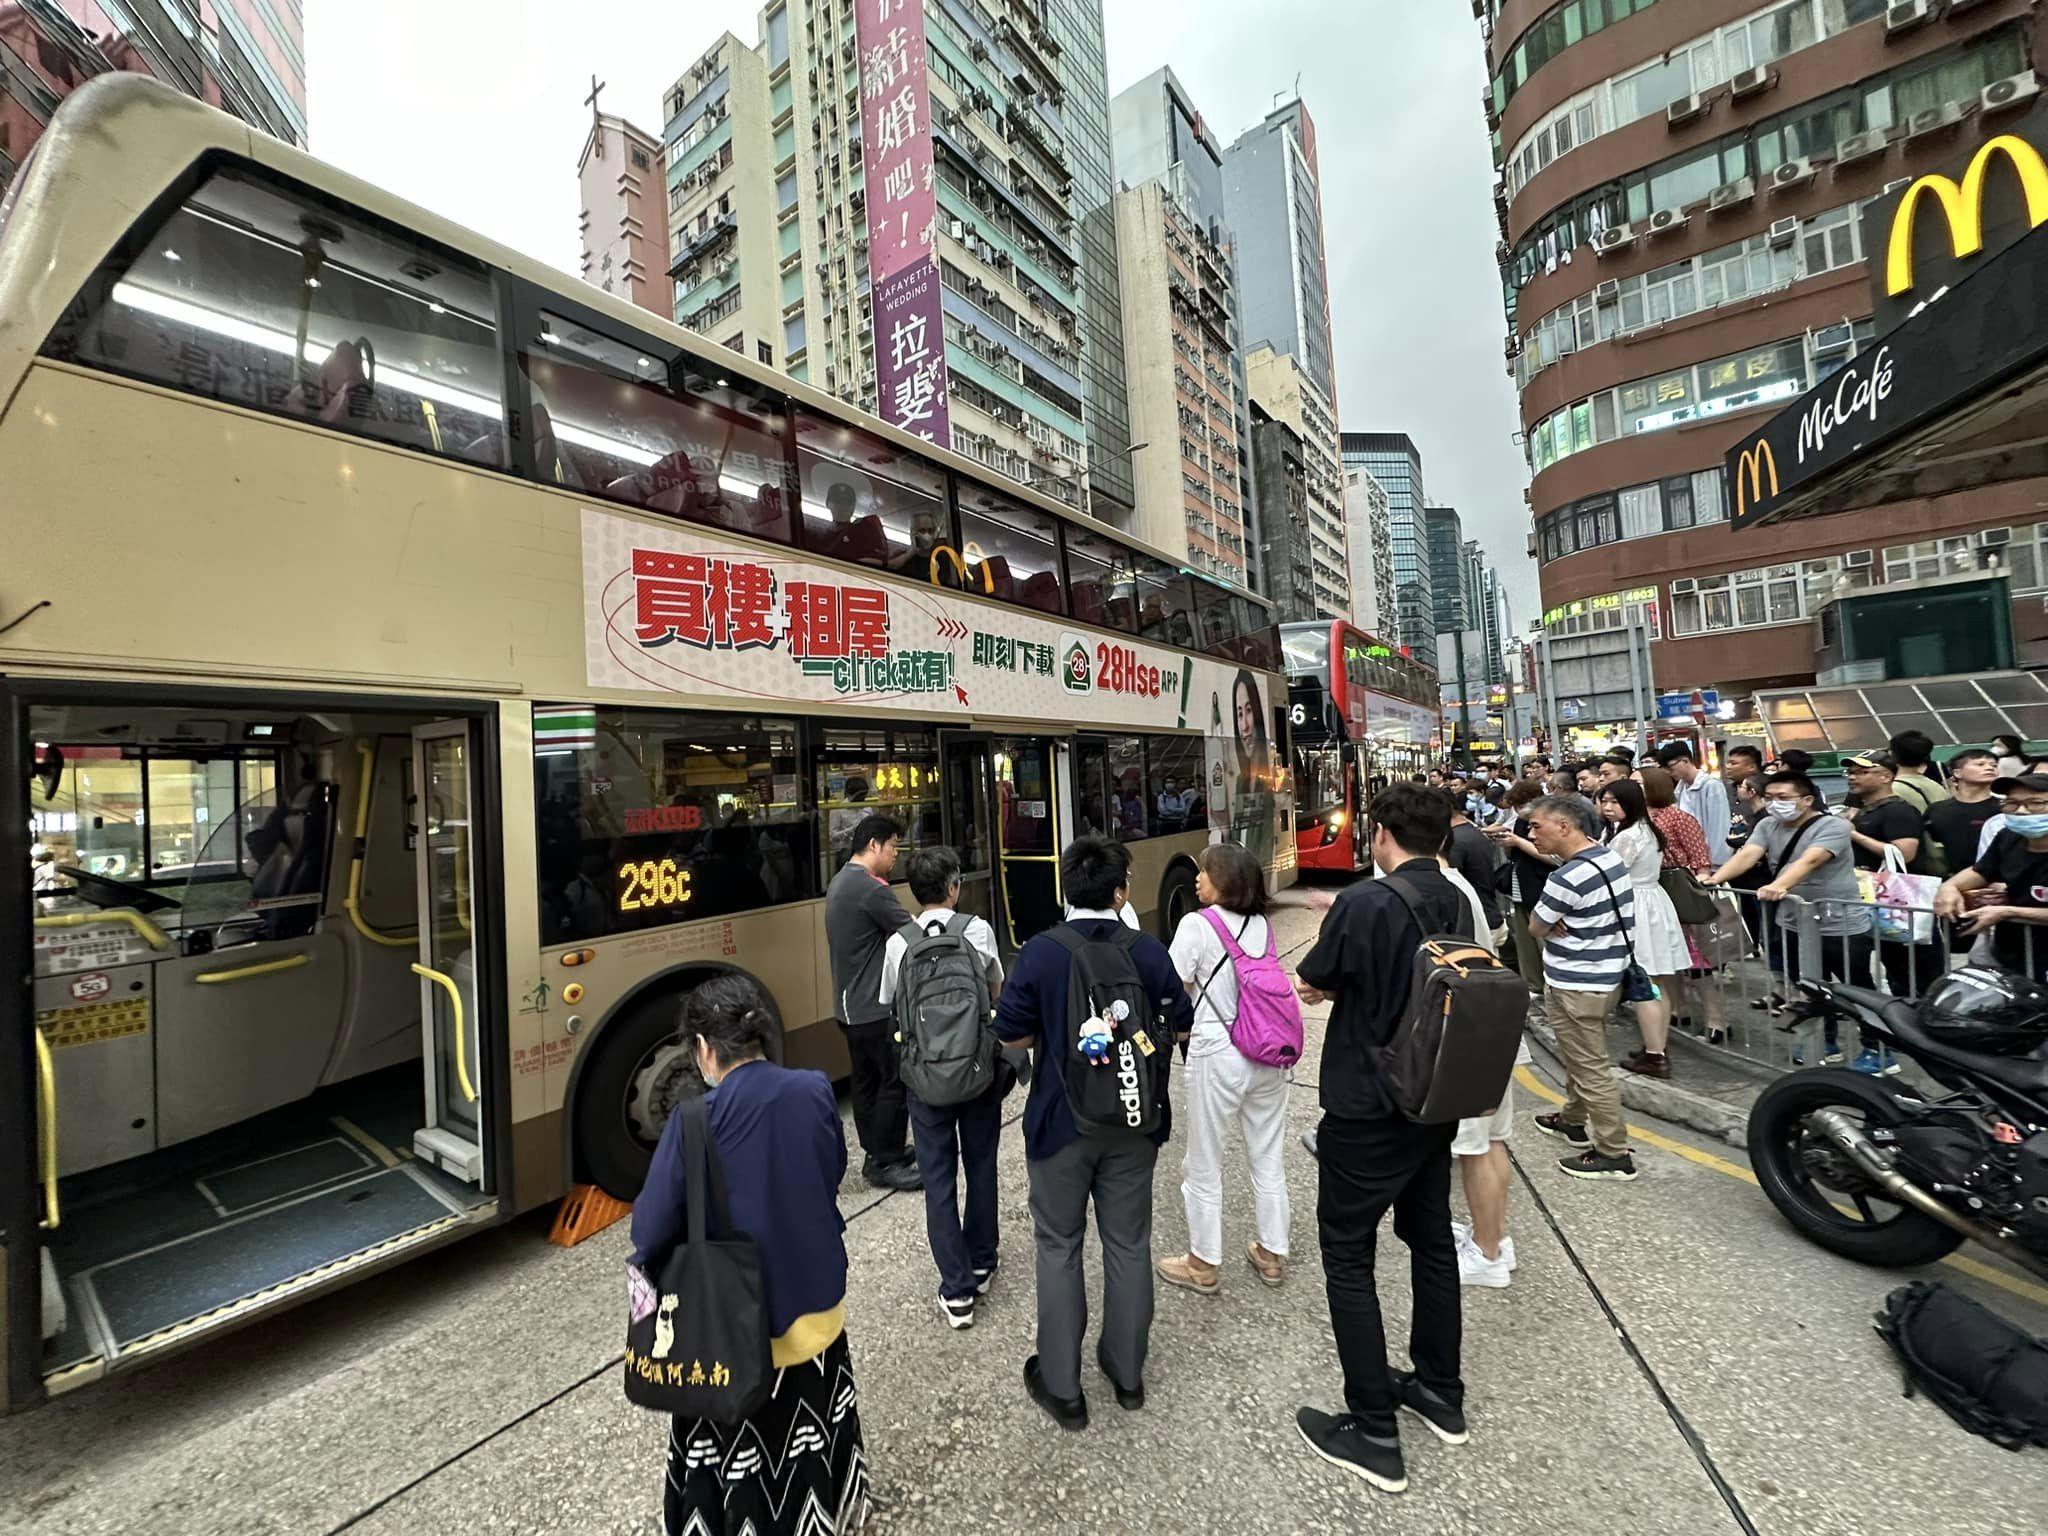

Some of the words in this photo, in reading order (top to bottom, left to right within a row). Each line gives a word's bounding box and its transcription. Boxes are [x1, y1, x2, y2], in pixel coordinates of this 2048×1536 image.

[879, 263, 934, 302] LAFAYETTE
[886, 282, 928, 312] WEDDING
[1798, 345, 1894, 465] McCafé
[972, 631, 1055, 677] 即刻下載
[1072, 656, 1085, 673] 28
[1096, 641, 1160, 699] 28Hse
[80, 982, 102, 994] 5G
[1117, 1040, 1141, 1127] adidas
